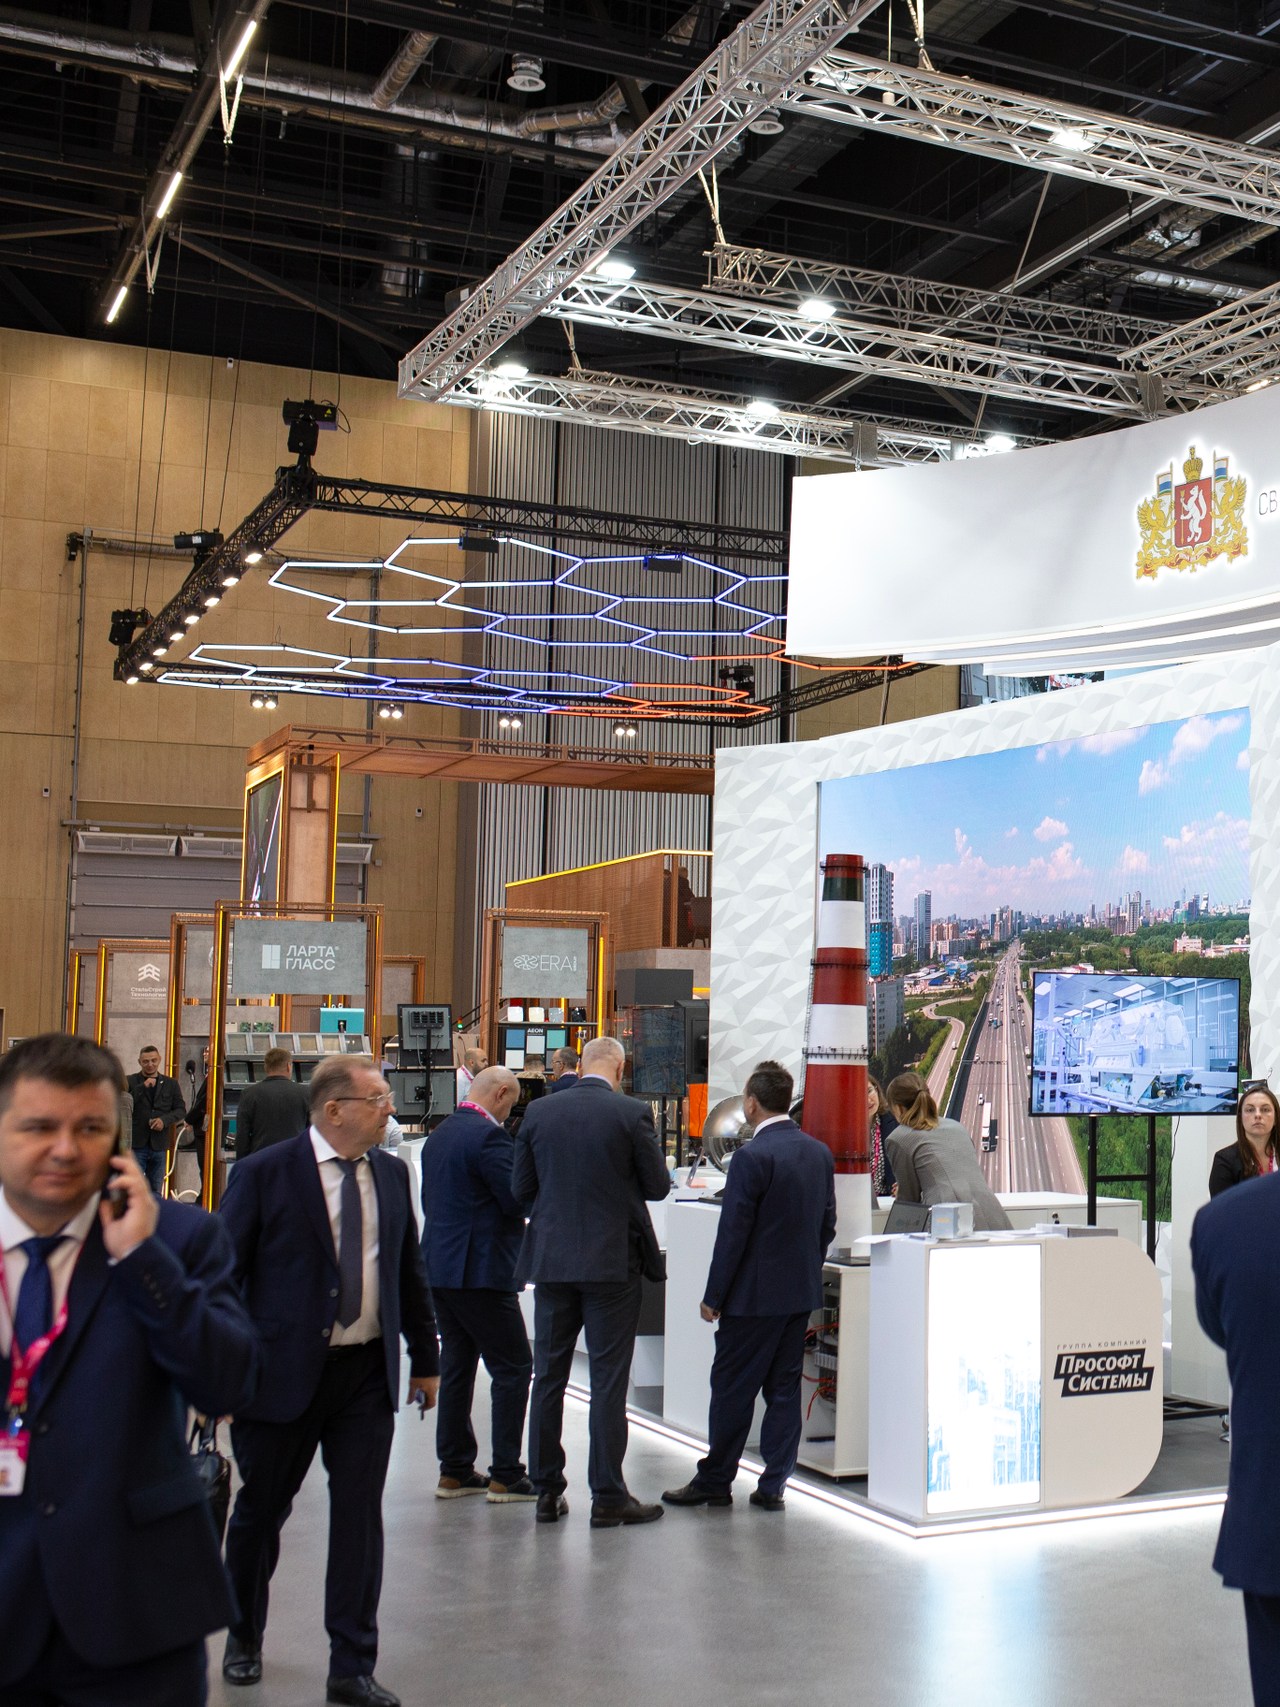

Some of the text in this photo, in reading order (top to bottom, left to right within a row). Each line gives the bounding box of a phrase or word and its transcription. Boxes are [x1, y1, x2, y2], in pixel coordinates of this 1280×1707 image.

[286, 944, 336, 958] ЛАРТА
[285, 958, 336, 971] ГЛАСС
[540, 954, 573, 971] ERA
[1098, 1339, 1147, 1347] КОМПАНИЙ
